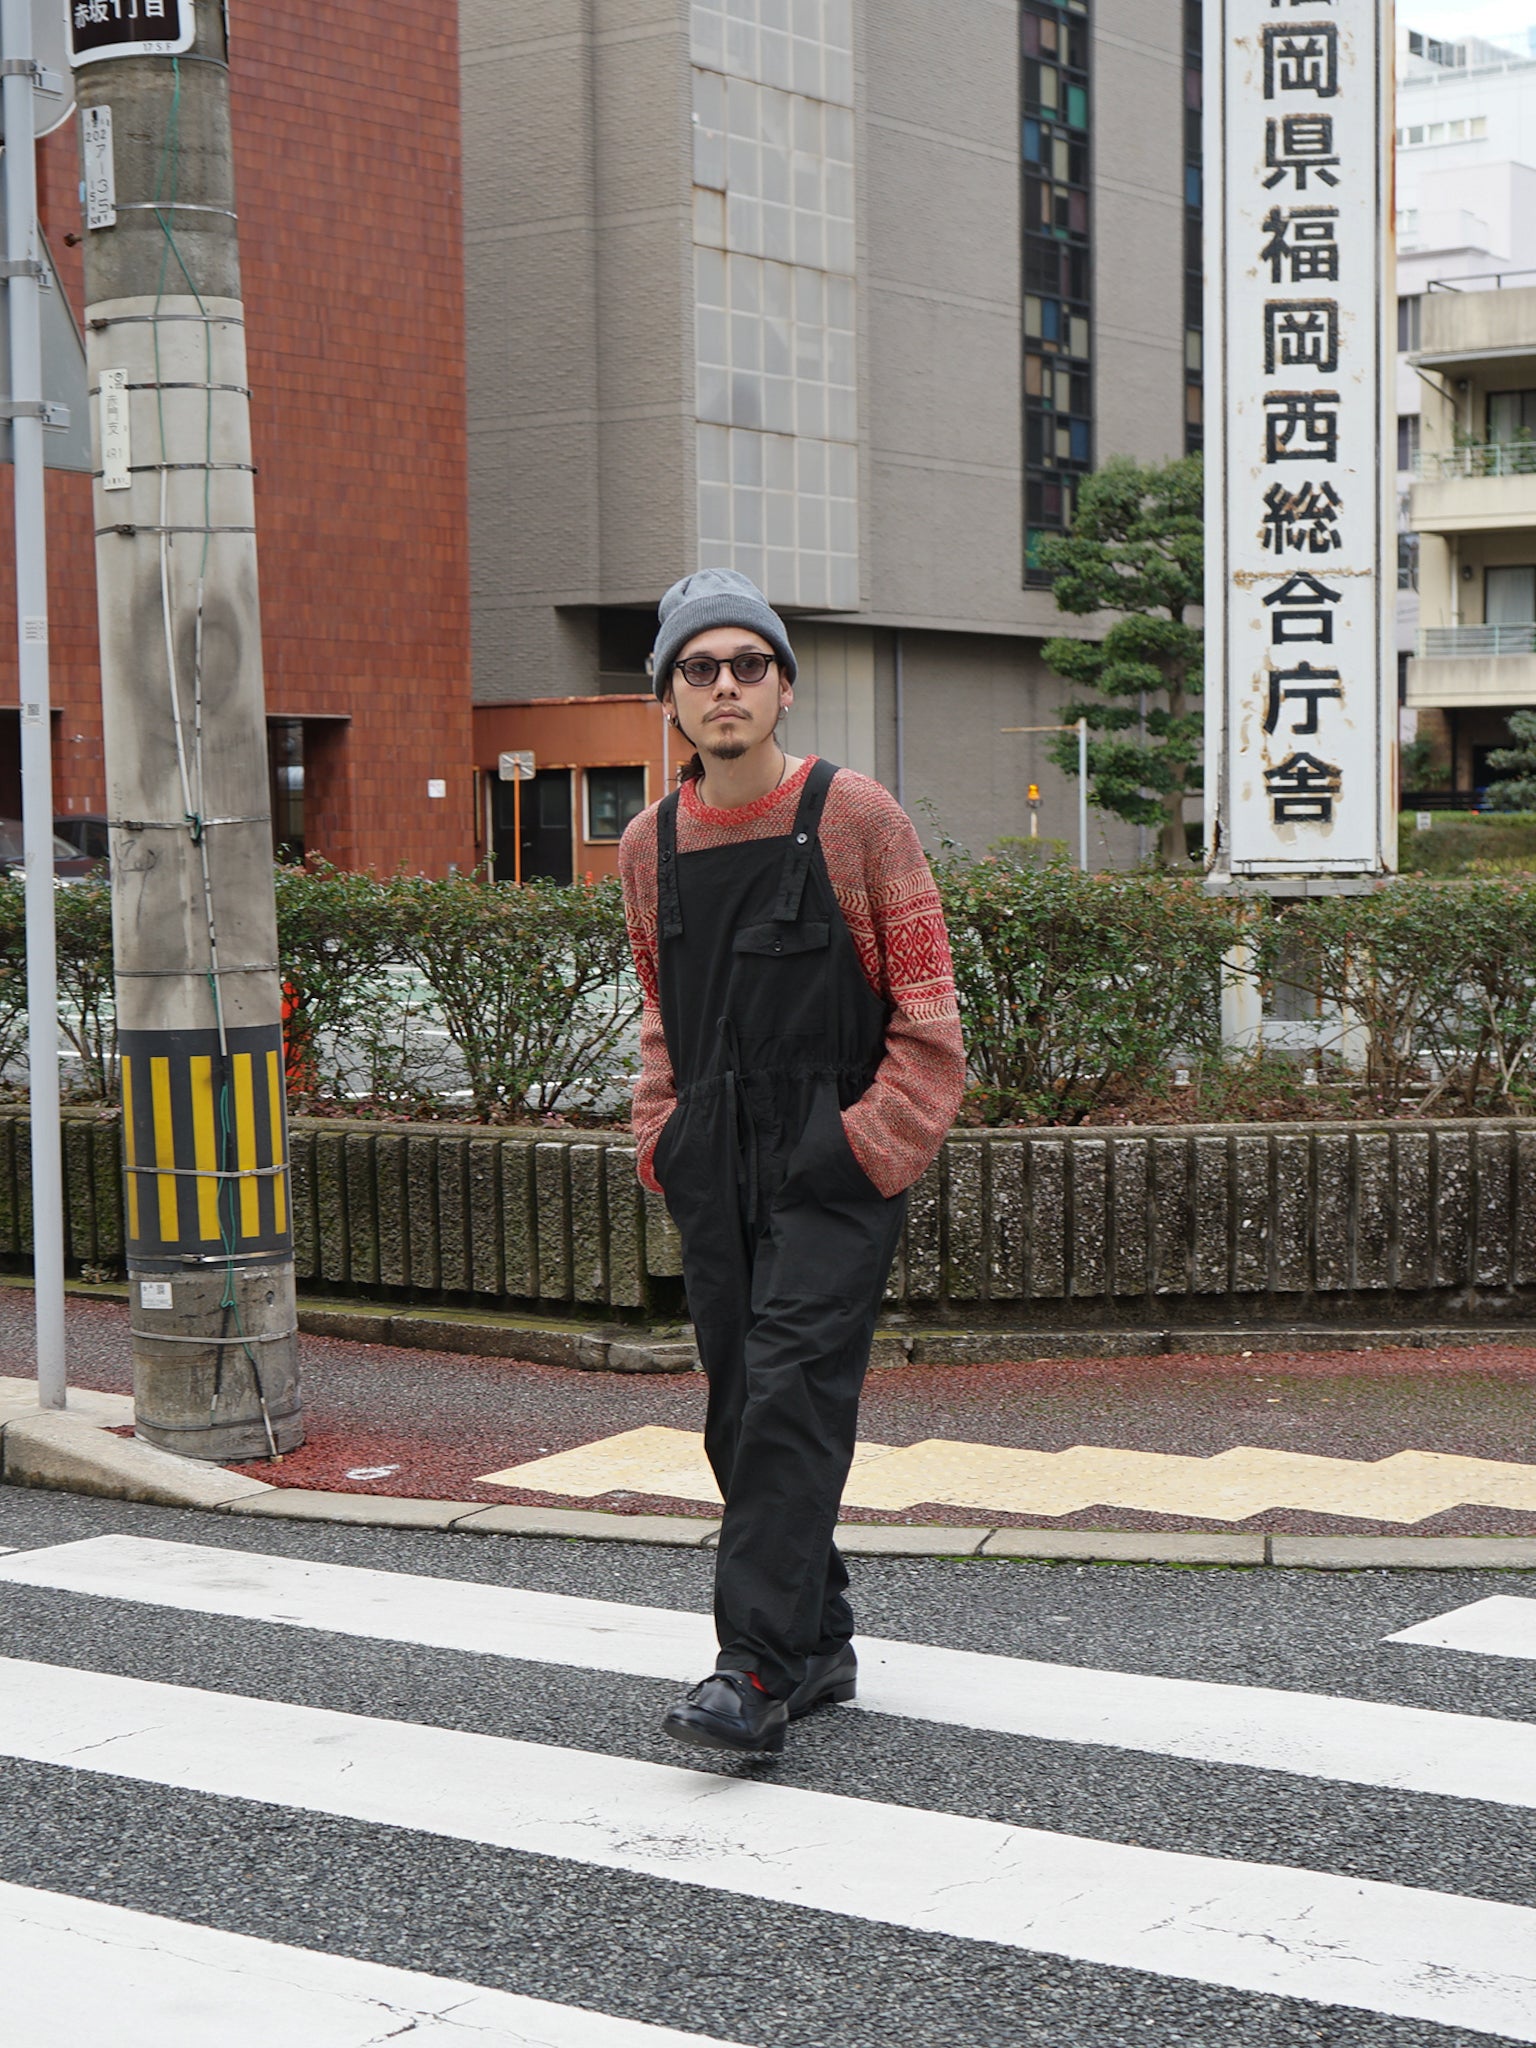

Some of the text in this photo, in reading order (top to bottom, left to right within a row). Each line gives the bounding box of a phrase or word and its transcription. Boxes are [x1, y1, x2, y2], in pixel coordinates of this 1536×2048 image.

[1262, 0, 1342, 823] 岡県福岡西総合庁舎
